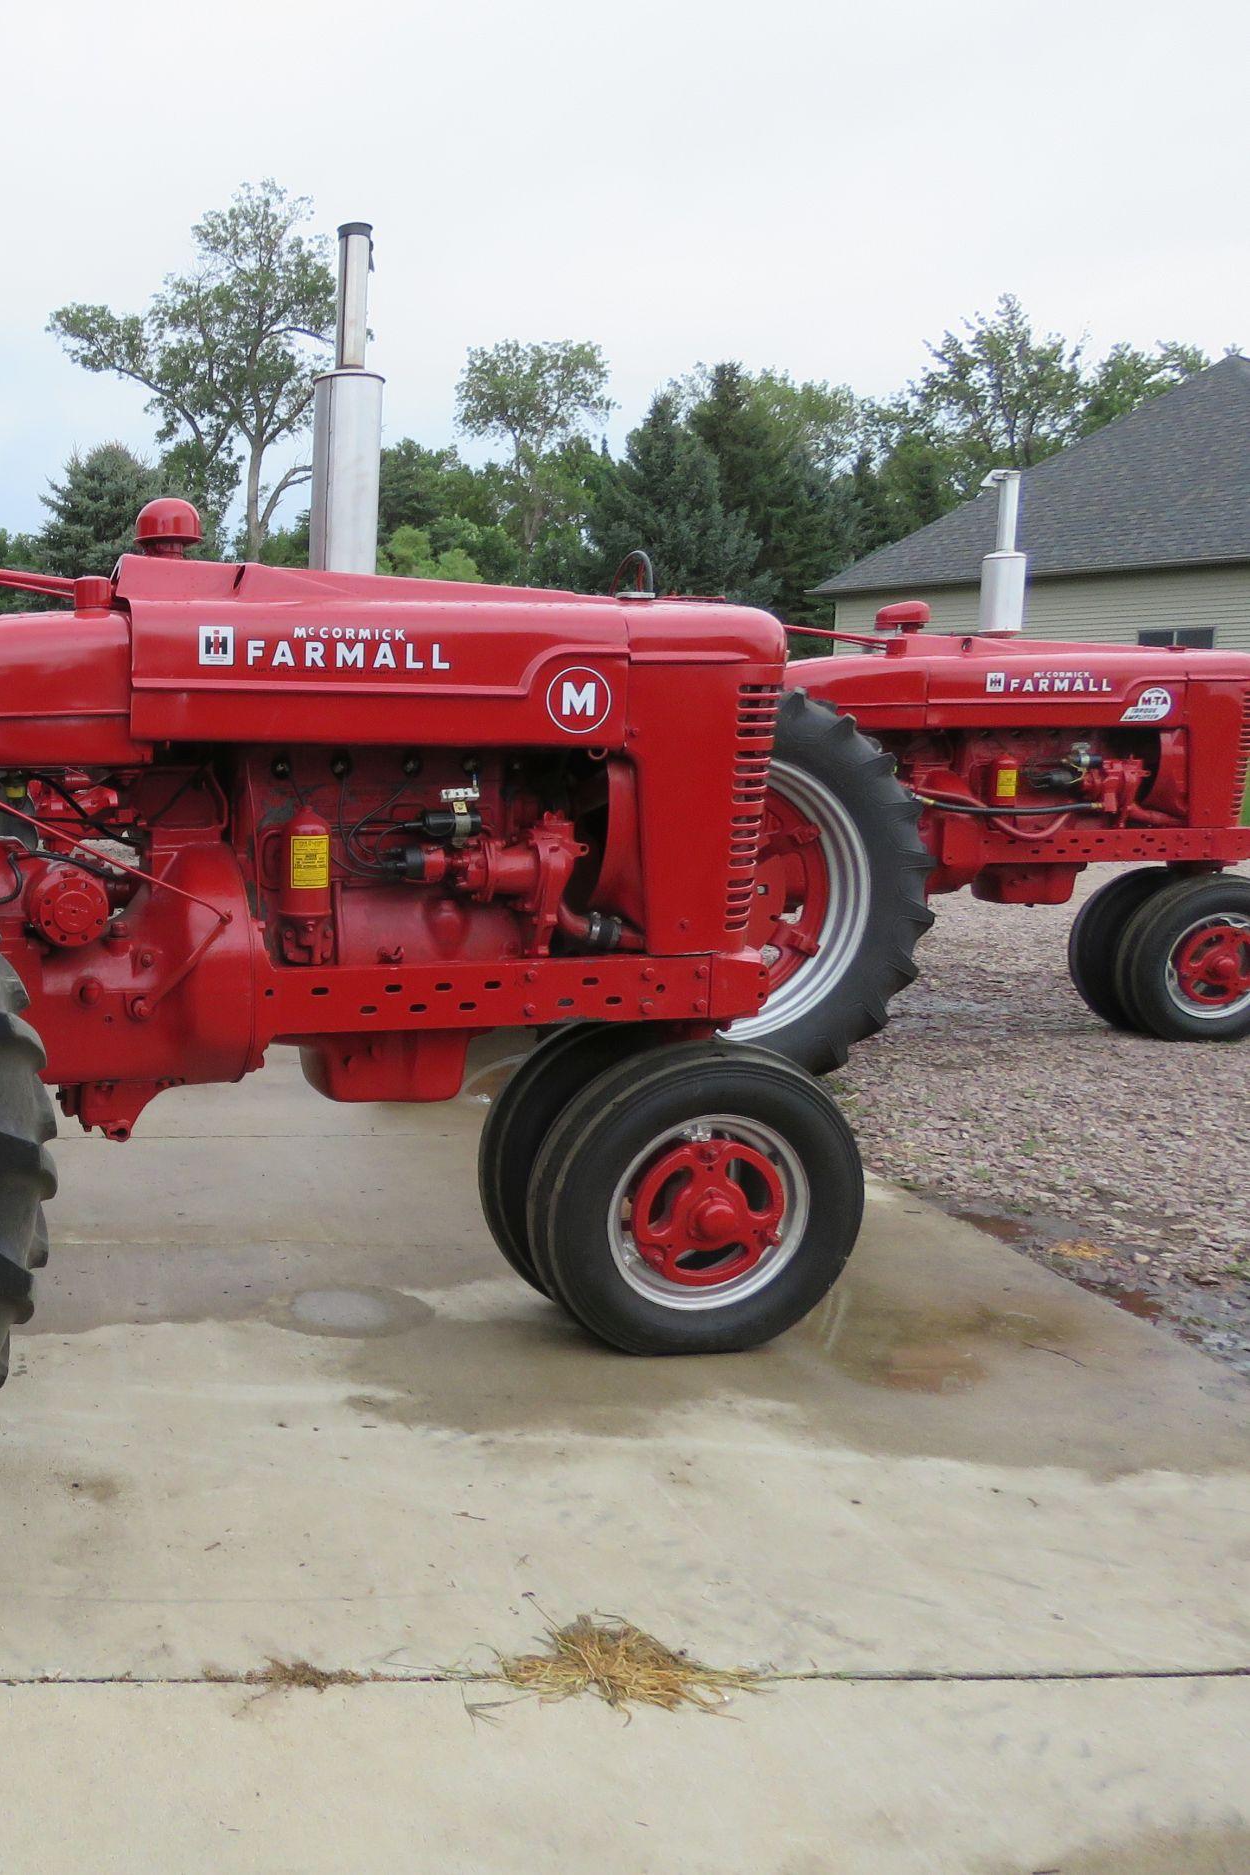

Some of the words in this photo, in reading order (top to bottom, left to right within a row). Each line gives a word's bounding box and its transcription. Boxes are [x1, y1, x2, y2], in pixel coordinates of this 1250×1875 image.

[246, 640, 452, 670] FARMALL
[1009, 678, 1112, 692] FARMALL
[561, 681, 597, 717] M
[1141, 696, 1169, 706] M-TA
